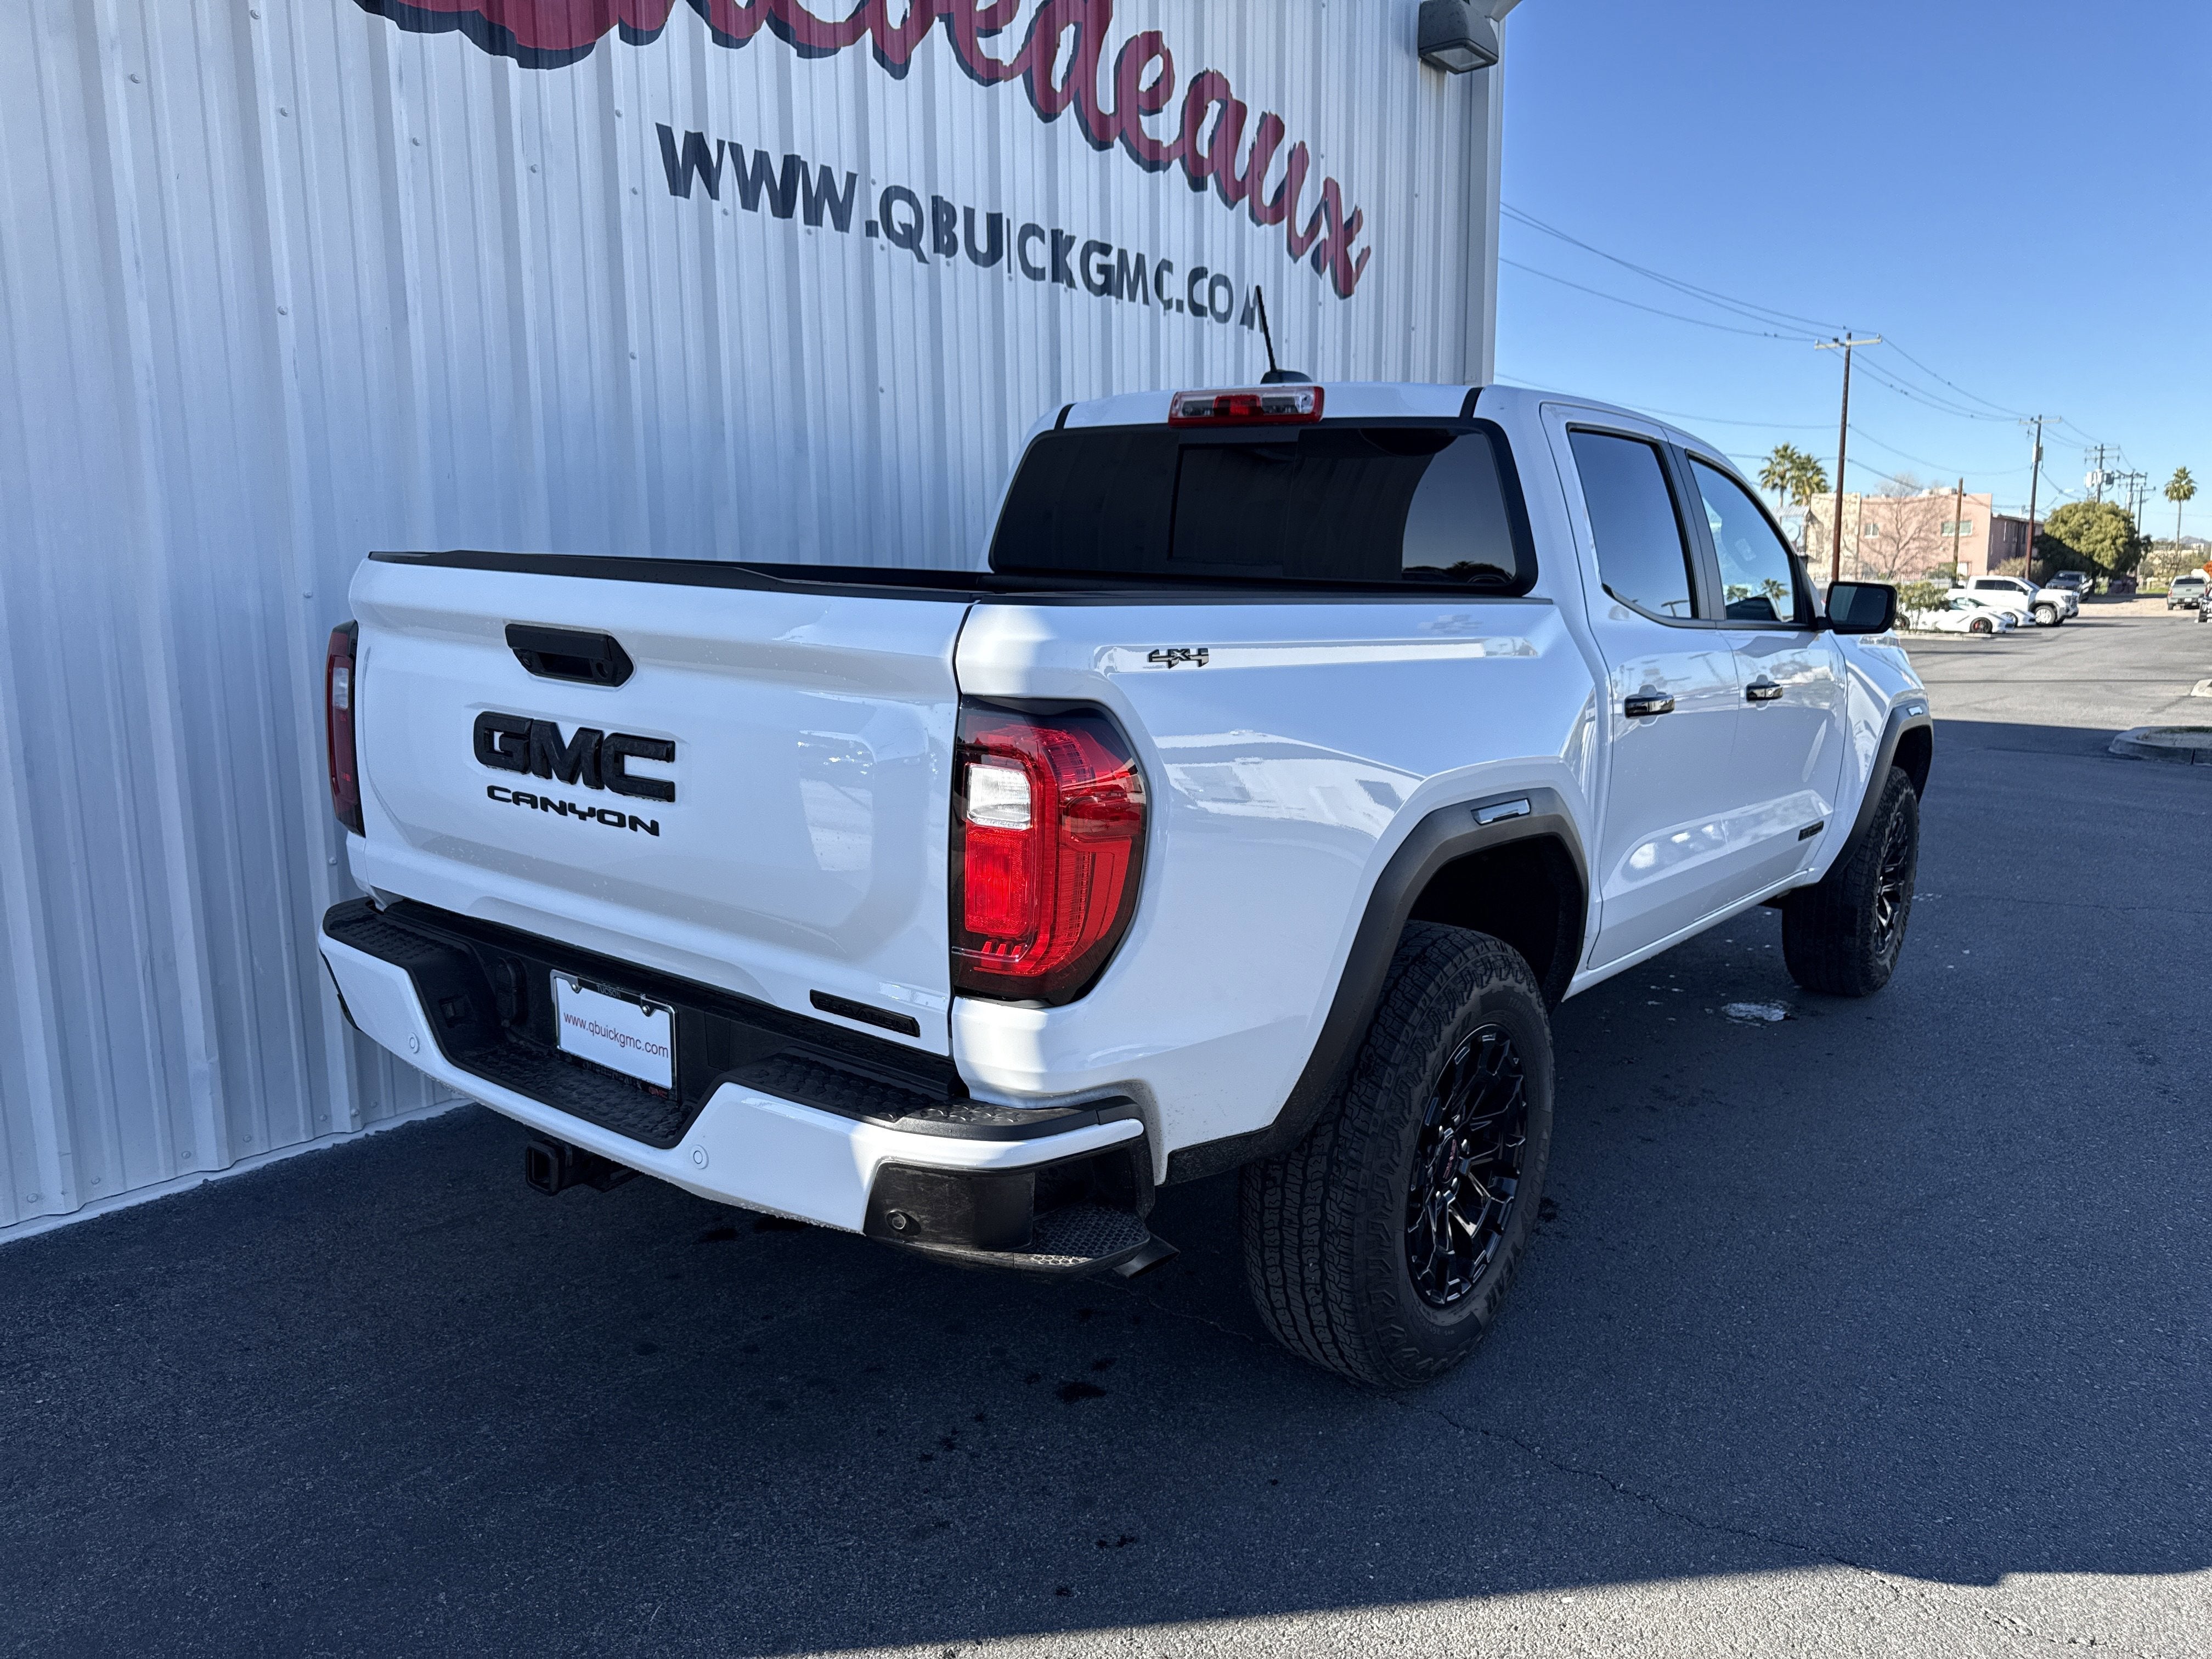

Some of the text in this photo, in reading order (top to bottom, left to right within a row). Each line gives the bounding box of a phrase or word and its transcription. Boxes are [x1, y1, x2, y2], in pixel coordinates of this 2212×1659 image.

[655, 122, 1265, 333] WWW.QBUICKGMC.COM
[473, 711, 675, 803] GMC
[487, 785, 659, 837] CANYON
[596, 984, 621, 999] TUCSON
[564, 1012, 668, 1058] www.qbuickgmc.com
